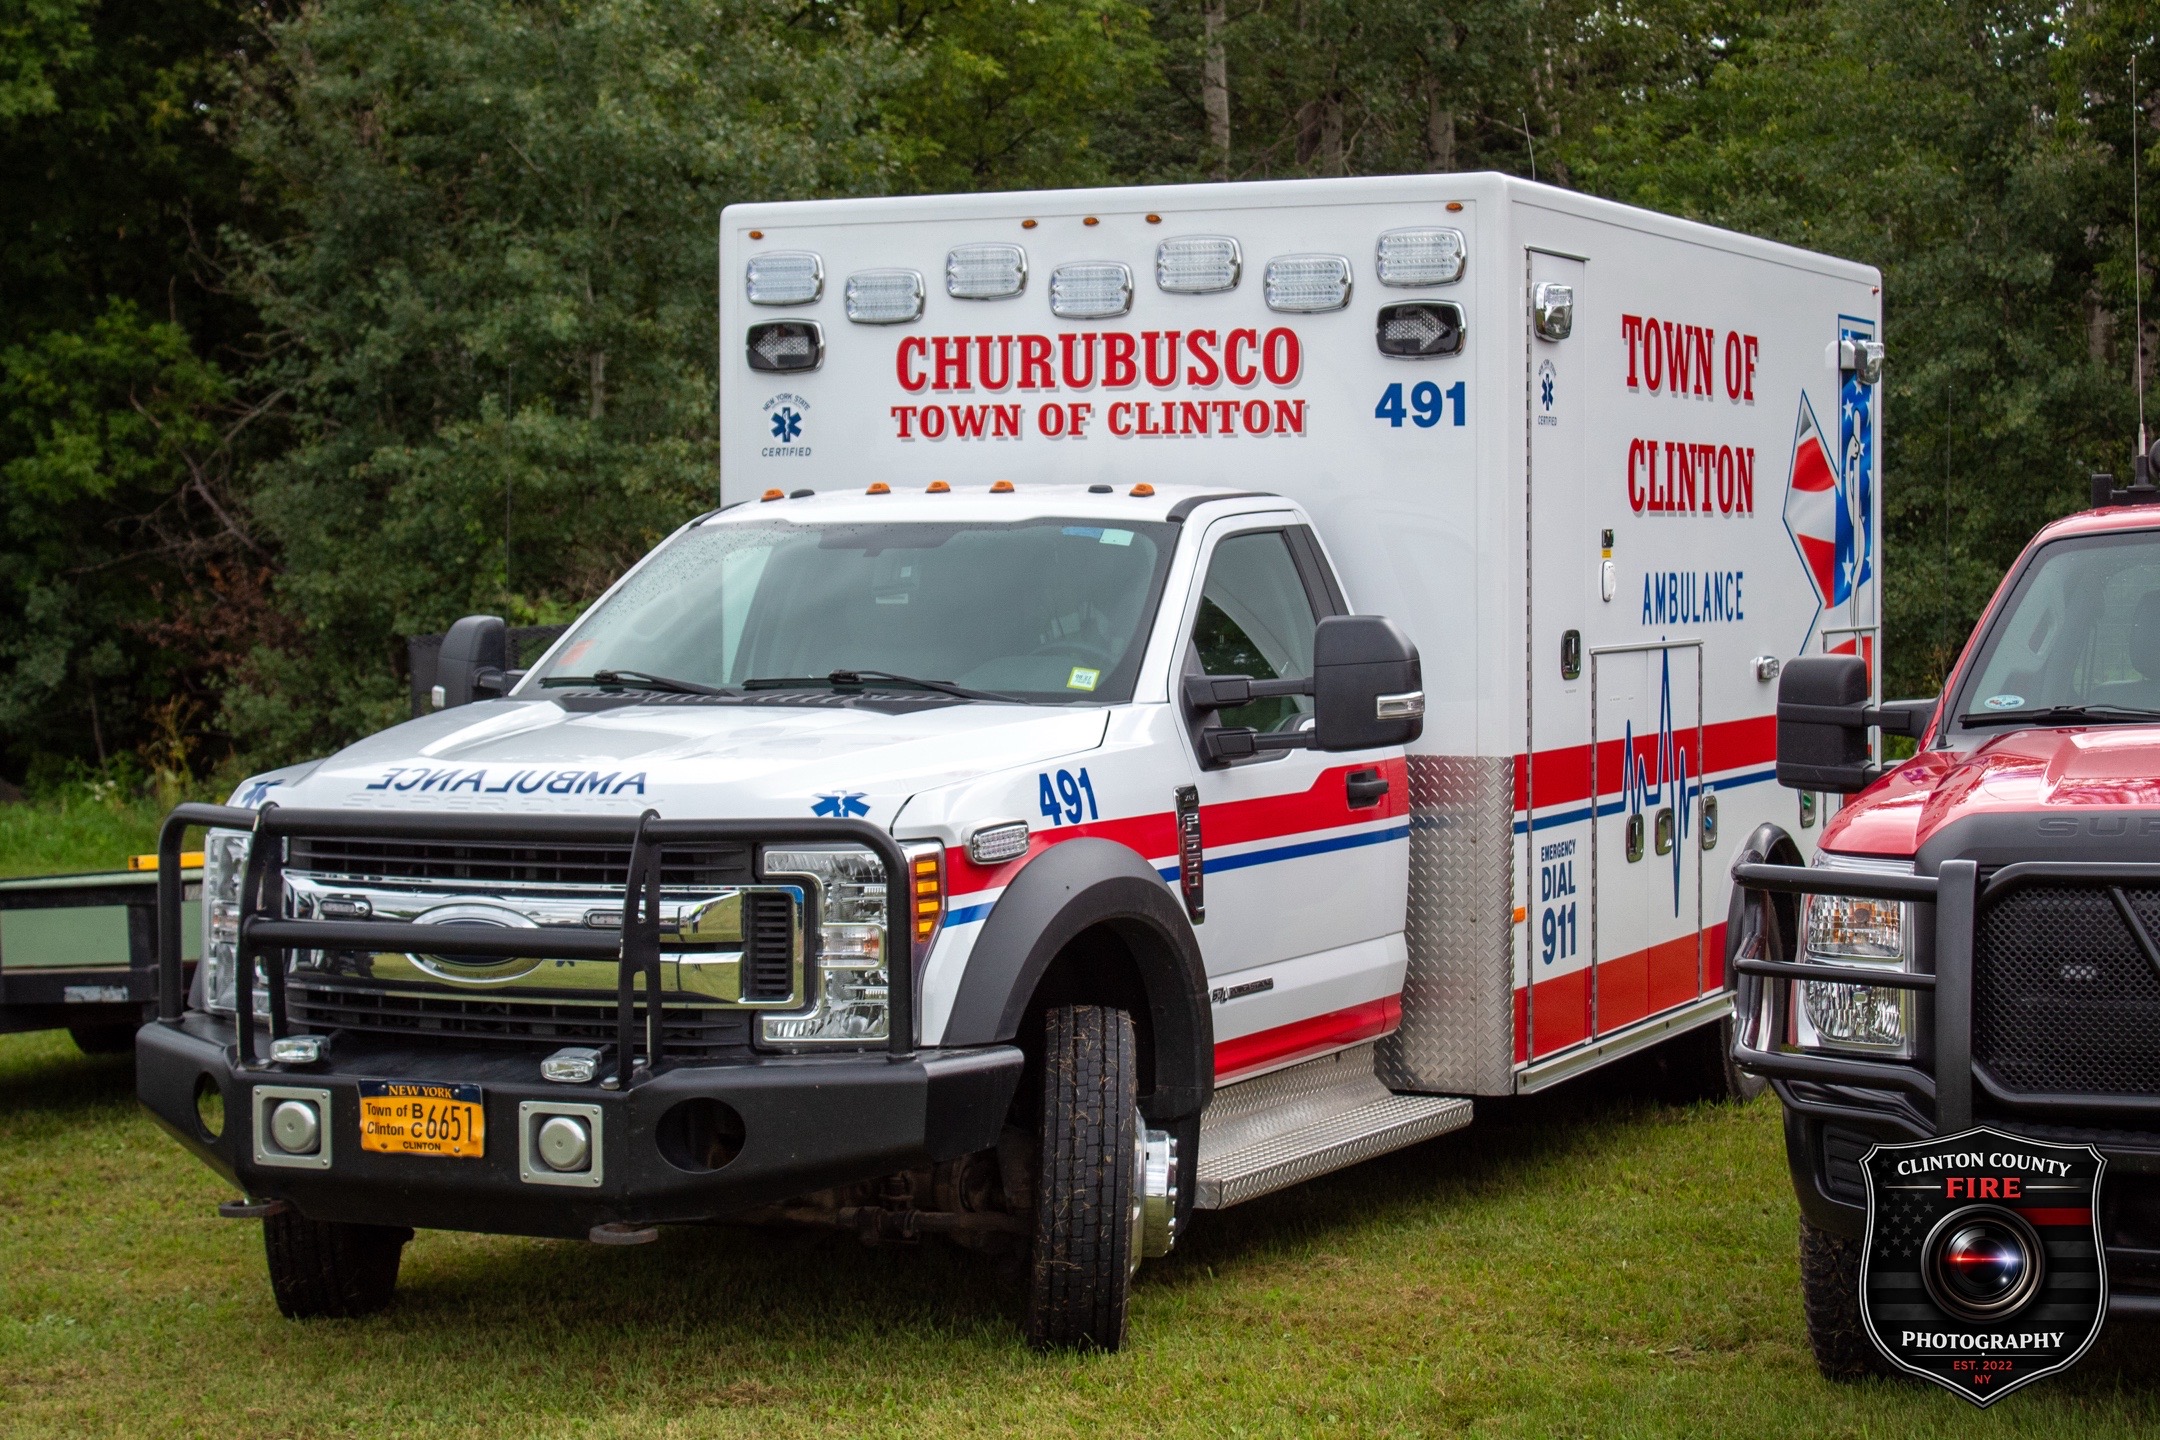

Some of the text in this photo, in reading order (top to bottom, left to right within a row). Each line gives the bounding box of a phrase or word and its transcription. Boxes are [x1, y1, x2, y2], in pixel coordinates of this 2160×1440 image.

[896, 326, 1301, 392] CHURUBUSCO
[1621, 313, 1758, 401] TOWN OF
[762, 398, 775, 411] NEW
[775, 393, 793, 401] YORK
[794, 395, 811, 411] STATE
[891, 400, 1305, 439] TOWN OF CLINTON
[1374, 381, 1467, 429] 491
[761, 446, 812, 458] CERTIFIED
[1628, 438, 1755, 514] CLINTON
[1642, 571, 1745, 626] AMBULANCE
[1039, 767, 1100, 827] 491
[1541, 839, 1576, 862] EMERGENCY
[1542, 860, 1576, 902] DIAL
[1542, 901, 1576, 965] 911
[366, 1103, 408, 1117] Town of
[388, 1085, 452, 1098] NEW YORK
[367, 1121, 404, 1136] Clinton
[426, 1105, 472, 1142] 6651
[402, 1141, 441, 1151] CLINTON
